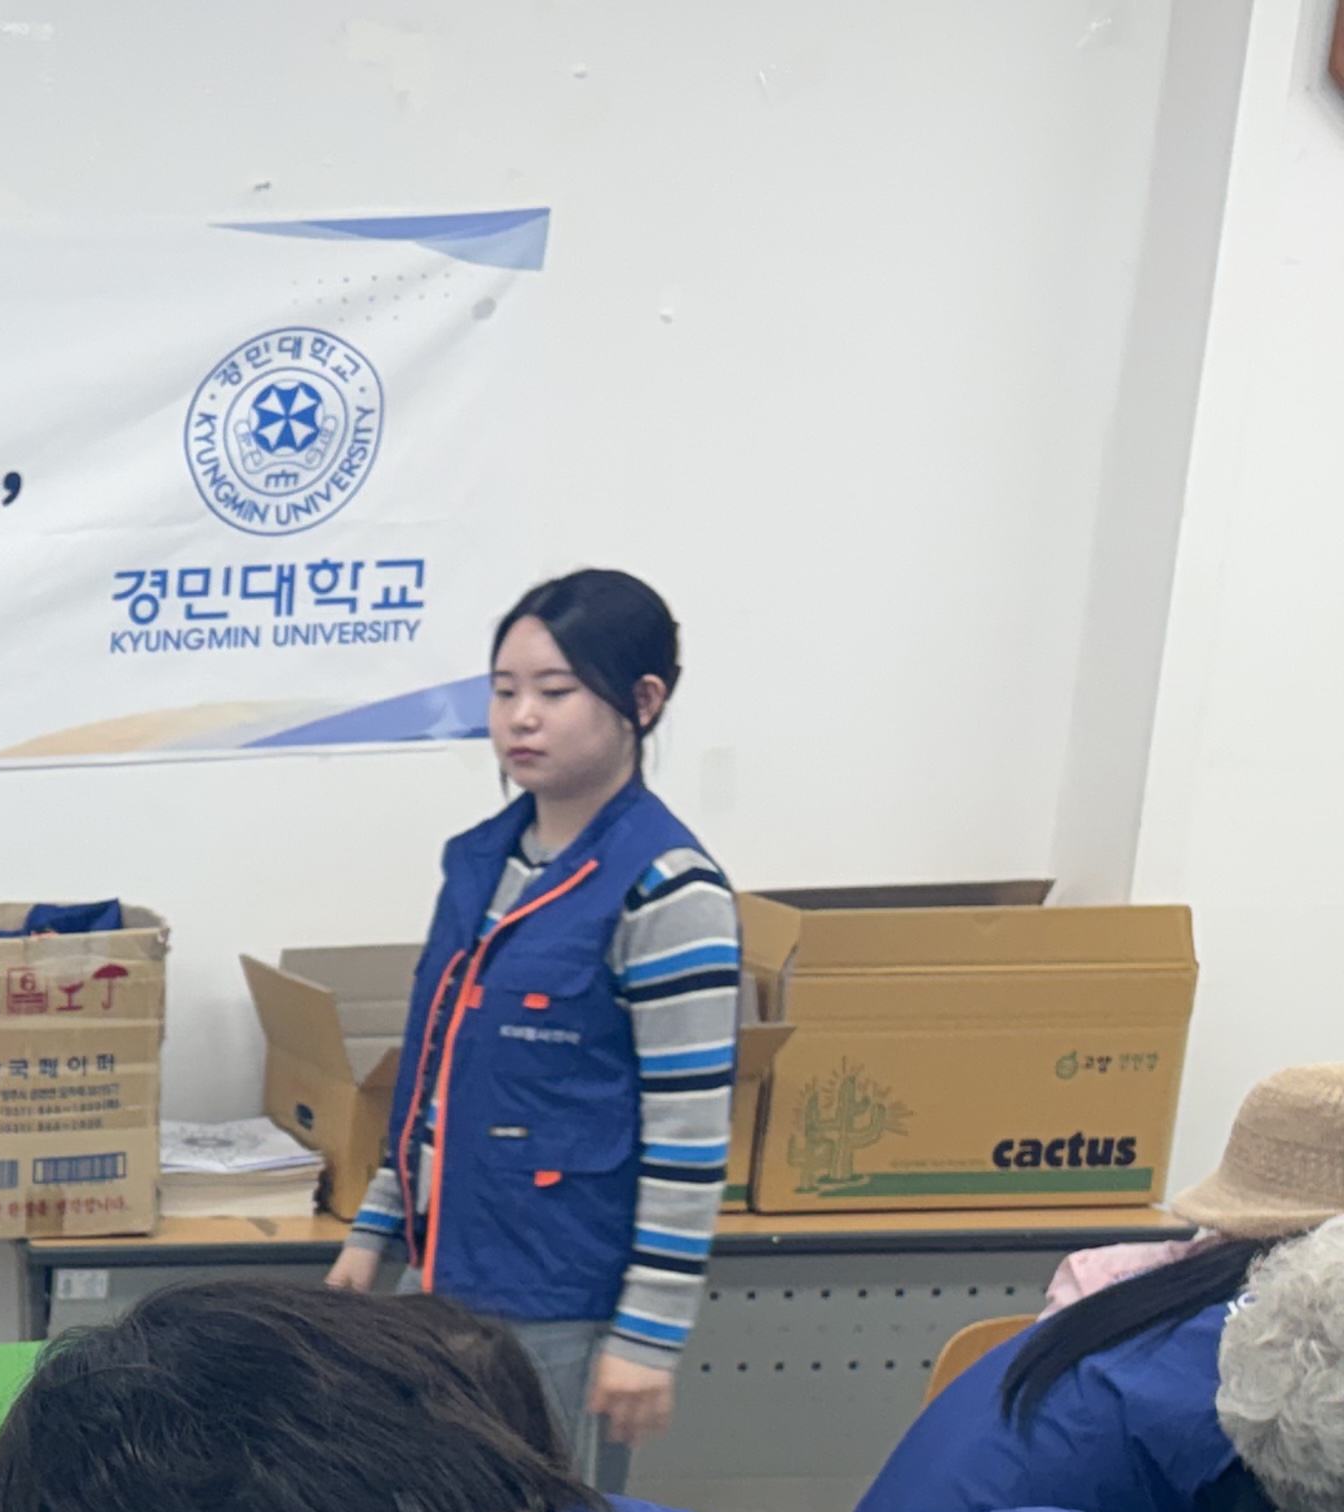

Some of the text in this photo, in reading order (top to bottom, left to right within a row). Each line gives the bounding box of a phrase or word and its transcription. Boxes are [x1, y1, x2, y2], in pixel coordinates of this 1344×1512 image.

[214, 335, 362, 388] 경민대학교
[195, 405, 376, 526] KYUNGMIN UNIVERSITY
[113, 558, 425, 625] 경민대학교
[110, 620, 421, 654] KYUNGMIN UNIVERSITY
[992, 1131, 1137, 1168] cactus
